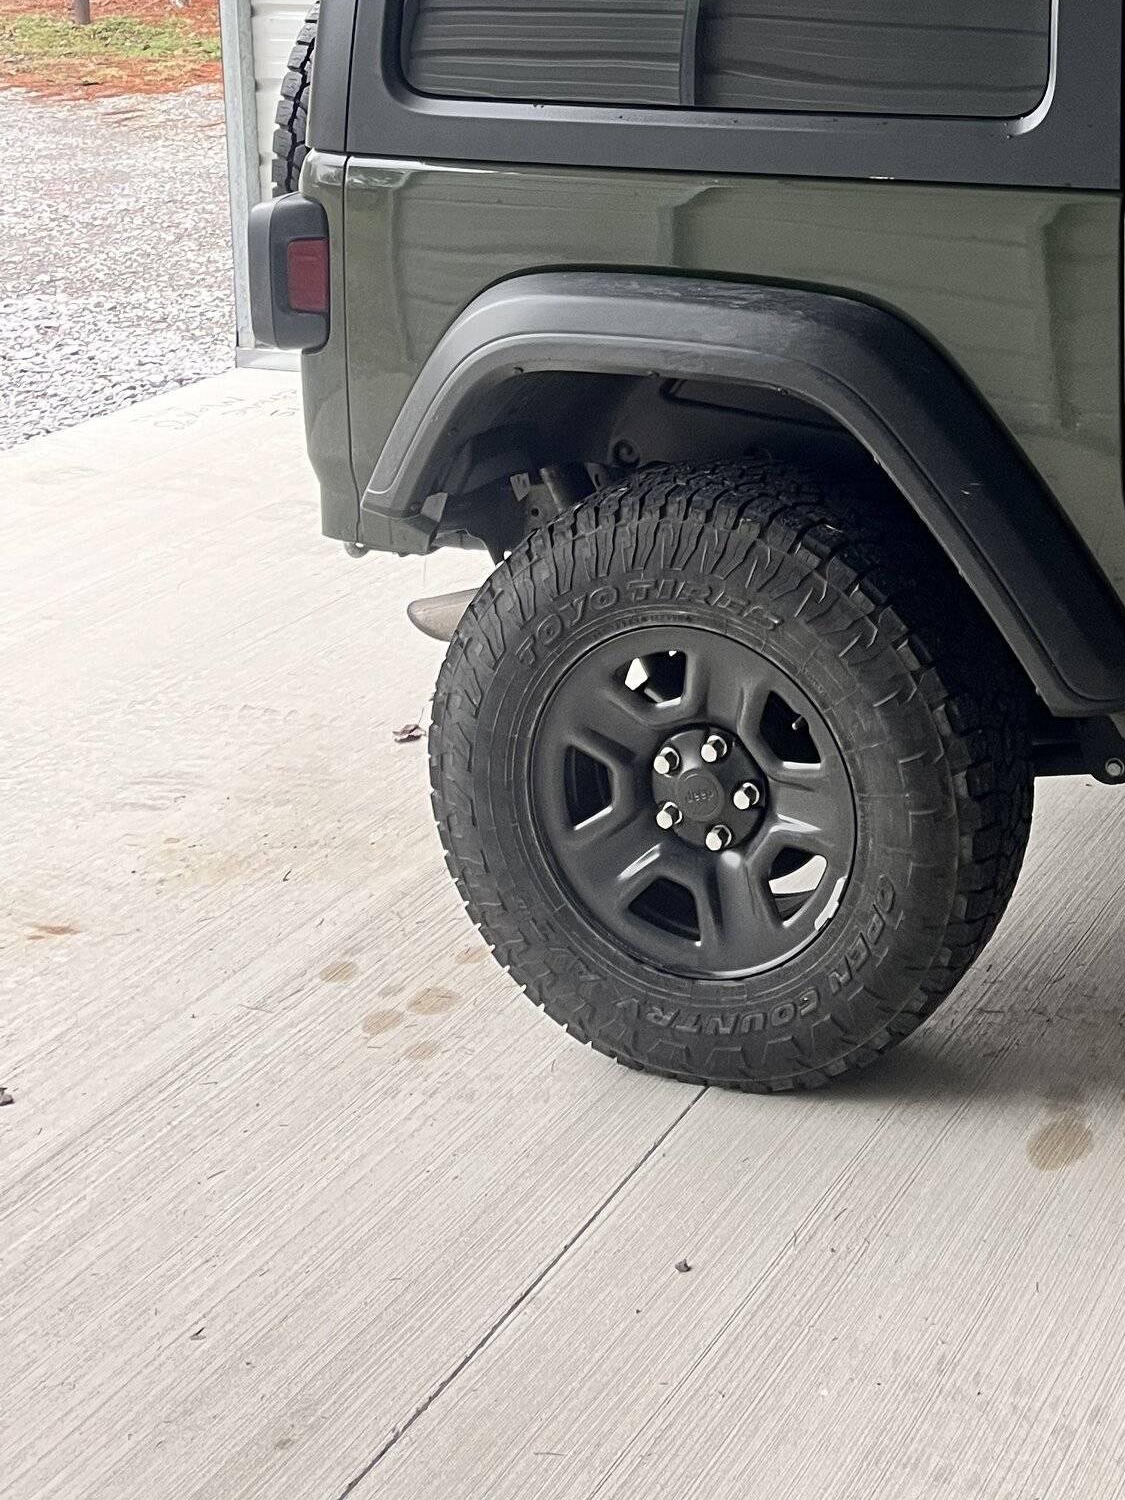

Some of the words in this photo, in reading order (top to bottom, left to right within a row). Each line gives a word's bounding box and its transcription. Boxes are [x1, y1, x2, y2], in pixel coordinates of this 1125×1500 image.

[515, 584, 620, 666] TOYO
[827, 872, 896, 996] OPEN
[614, 985, 820, 1036] COUNTRY
